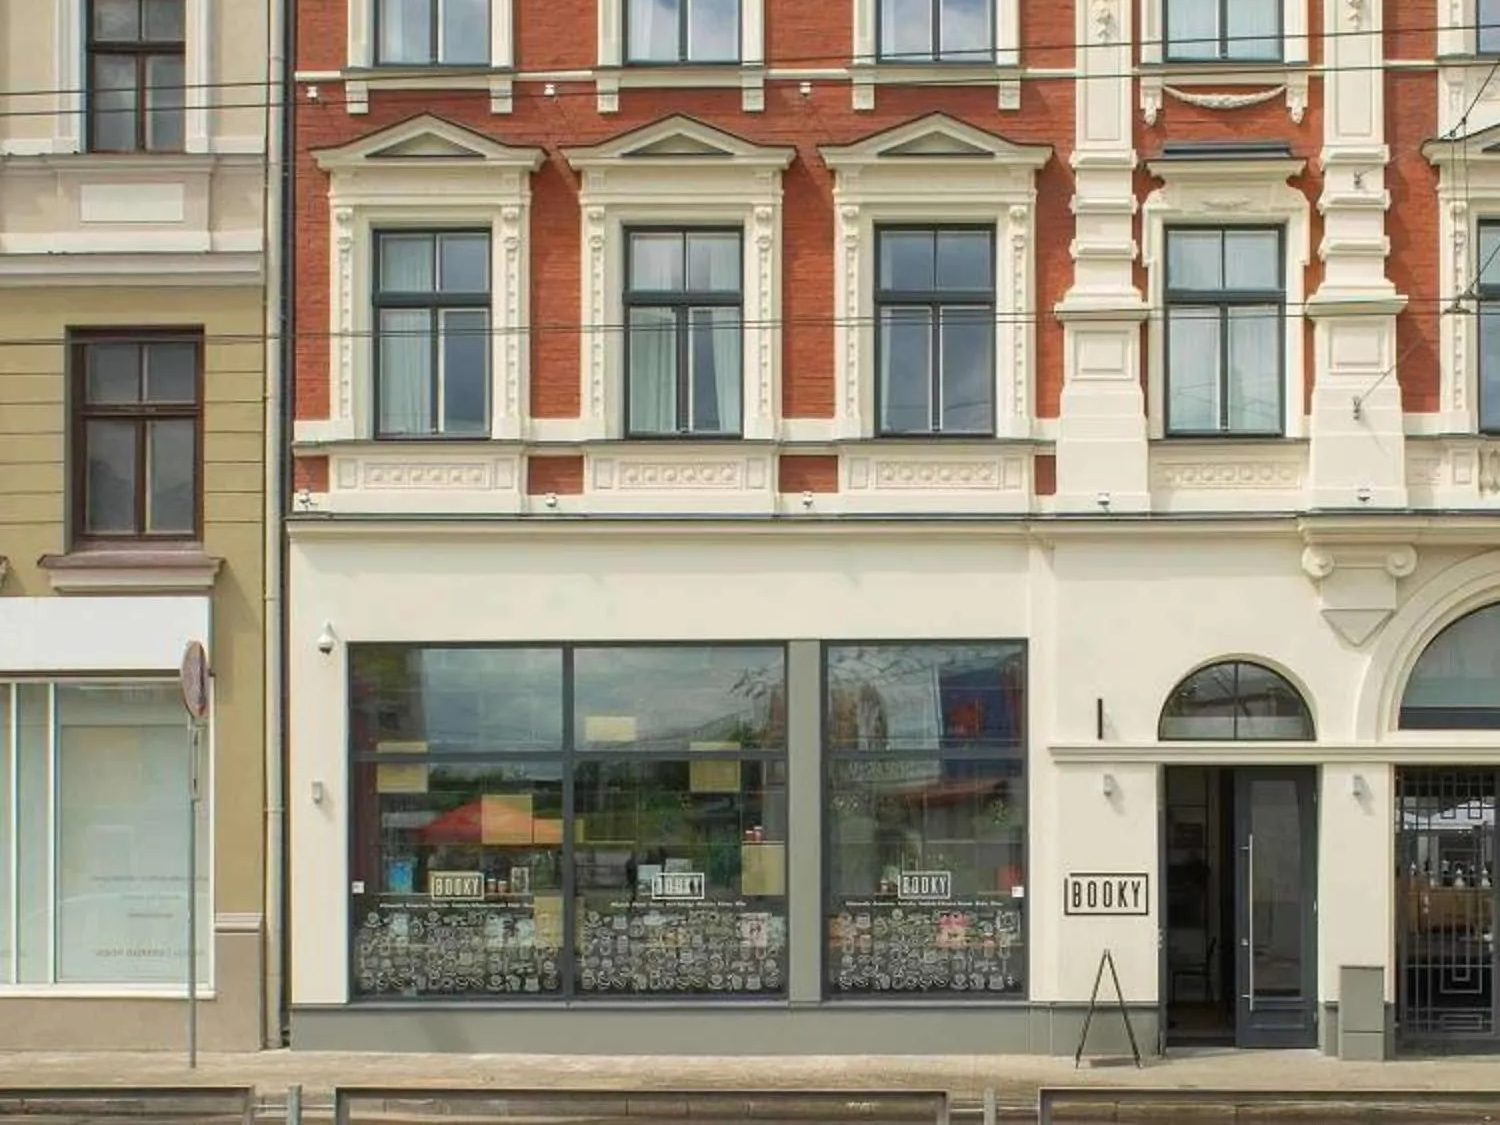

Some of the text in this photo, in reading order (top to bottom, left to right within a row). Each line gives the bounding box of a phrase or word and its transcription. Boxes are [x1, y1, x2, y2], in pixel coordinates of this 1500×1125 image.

[435, 878, 479, 896] BOOKY
[902, 876, 948, 894] BOOKY
[1072, 880, 1141, 908] BOOKY
